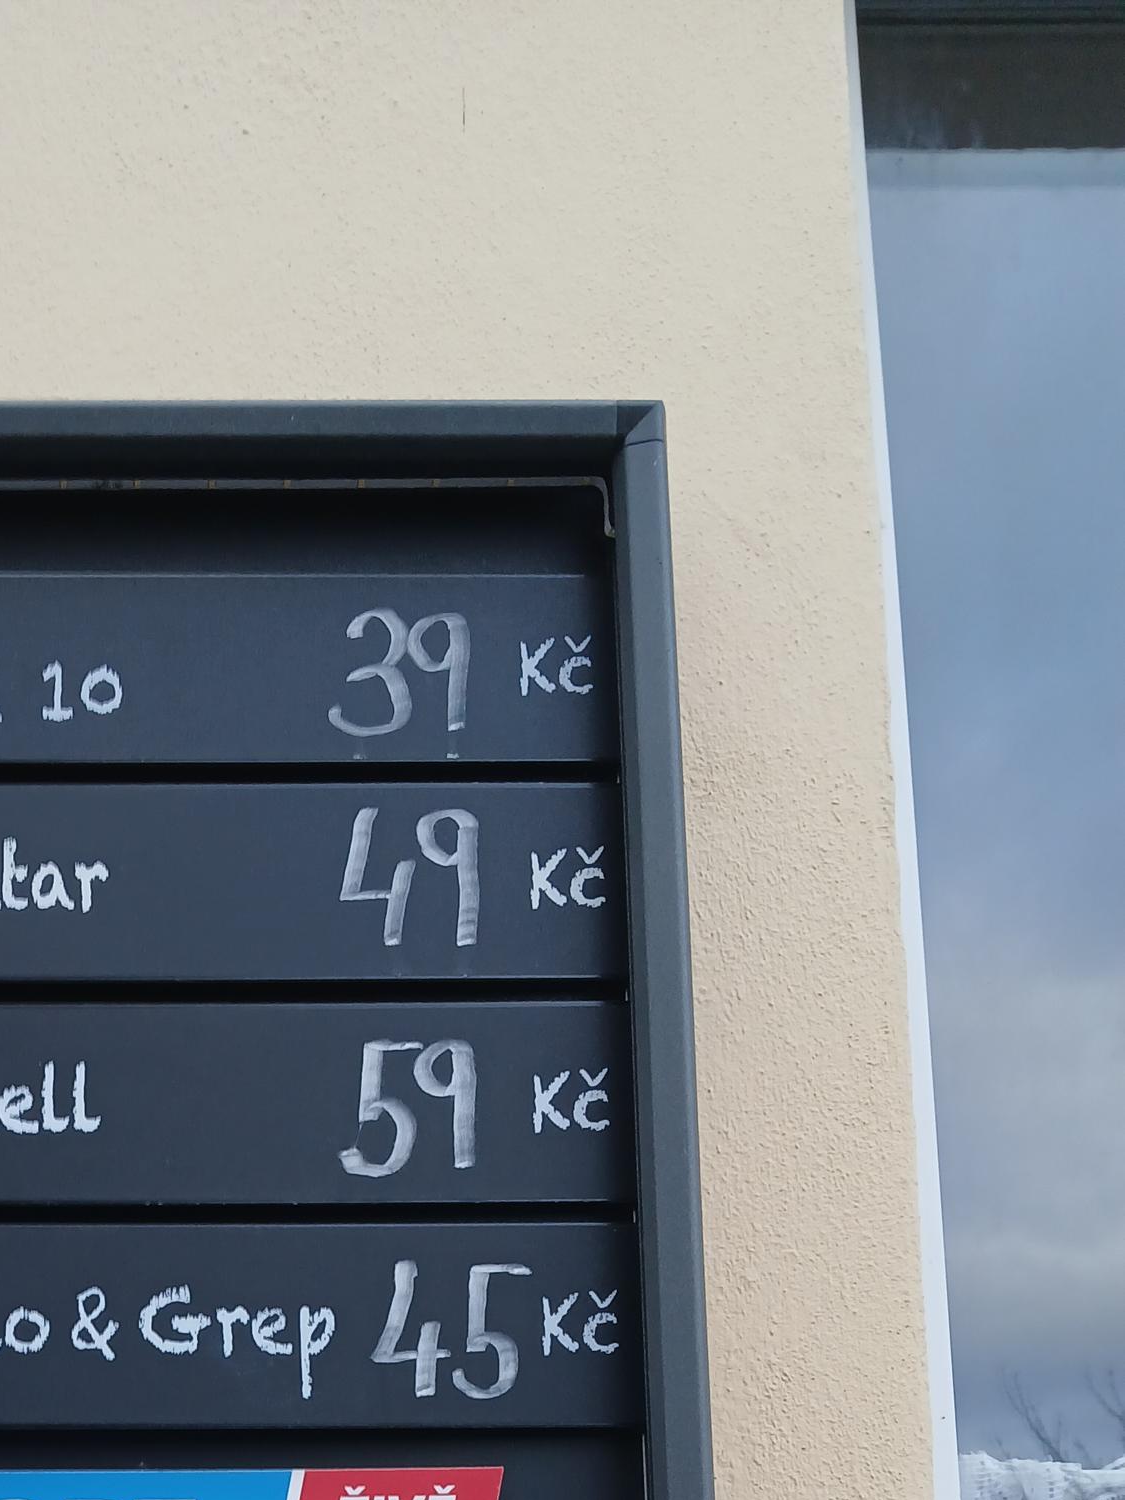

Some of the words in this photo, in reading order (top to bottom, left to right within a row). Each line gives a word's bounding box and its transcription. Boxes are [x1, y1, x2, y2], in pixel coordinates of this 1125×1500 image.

[43, 662, 122, 722] 10
[328, 610, 470, 737] 39
[520, 635, 593, 696] Kč
[339, 807, 480, 947] 49
[530, 846, 606, 910] Kč
[339, 1040, 477, 1177] 59
[532, 1068, 610, 1134] Kč
[71, 1287, 119, 1353] &
[139, 1284, 335, 1399] Grep
[371, 1260, 532, 1399] 45
[542, 1290, 619, 1356] Kč
